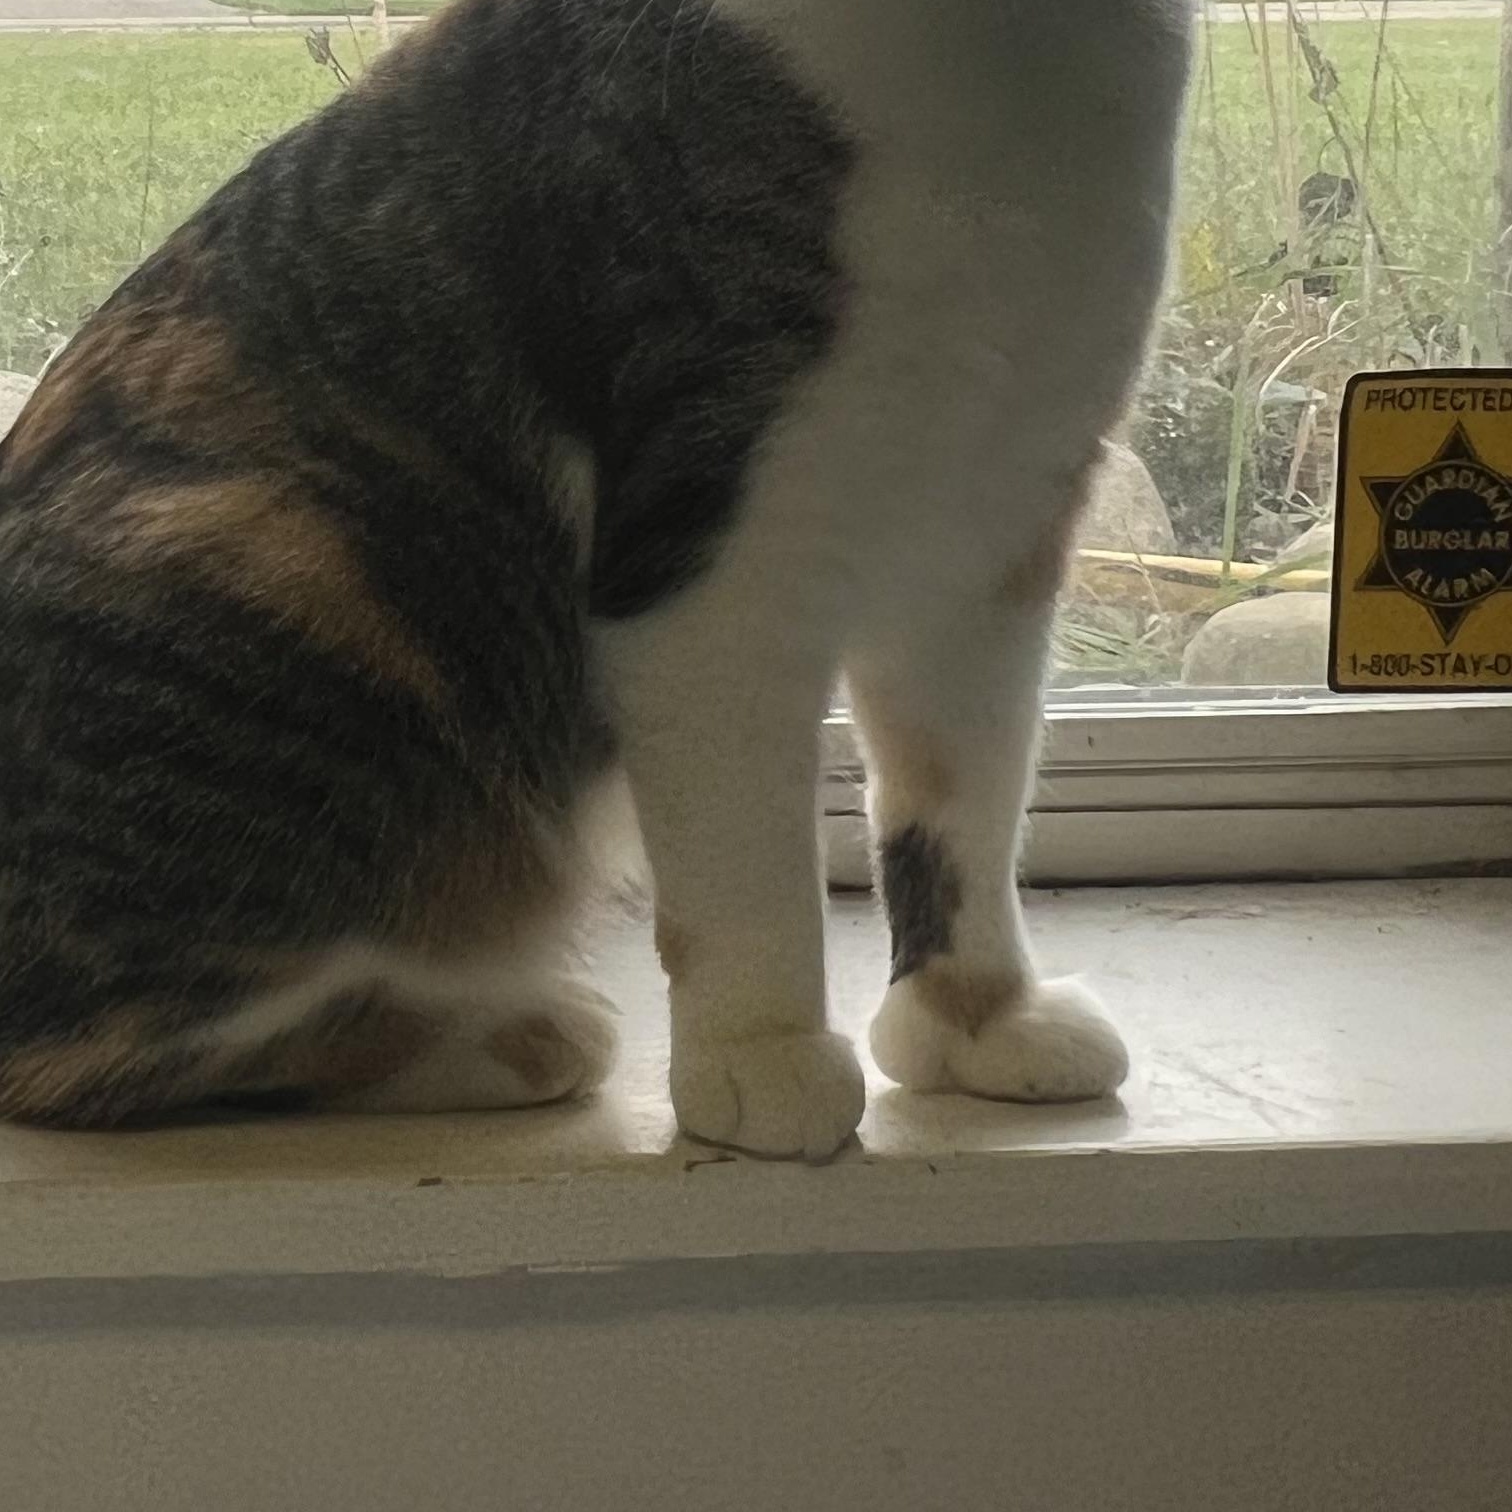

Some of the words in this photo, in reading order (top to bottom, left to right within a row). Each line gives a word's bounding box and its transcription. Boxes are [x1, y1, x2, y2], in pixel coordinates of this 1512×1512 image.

[1365, 388, 1512, 412] PROTECTED
[1394, 468, 1512, 523] GUARDIAN
[1394, 529, 1509, 550] BURGLAR
[1402, 567, 1497, 599] ALARM
